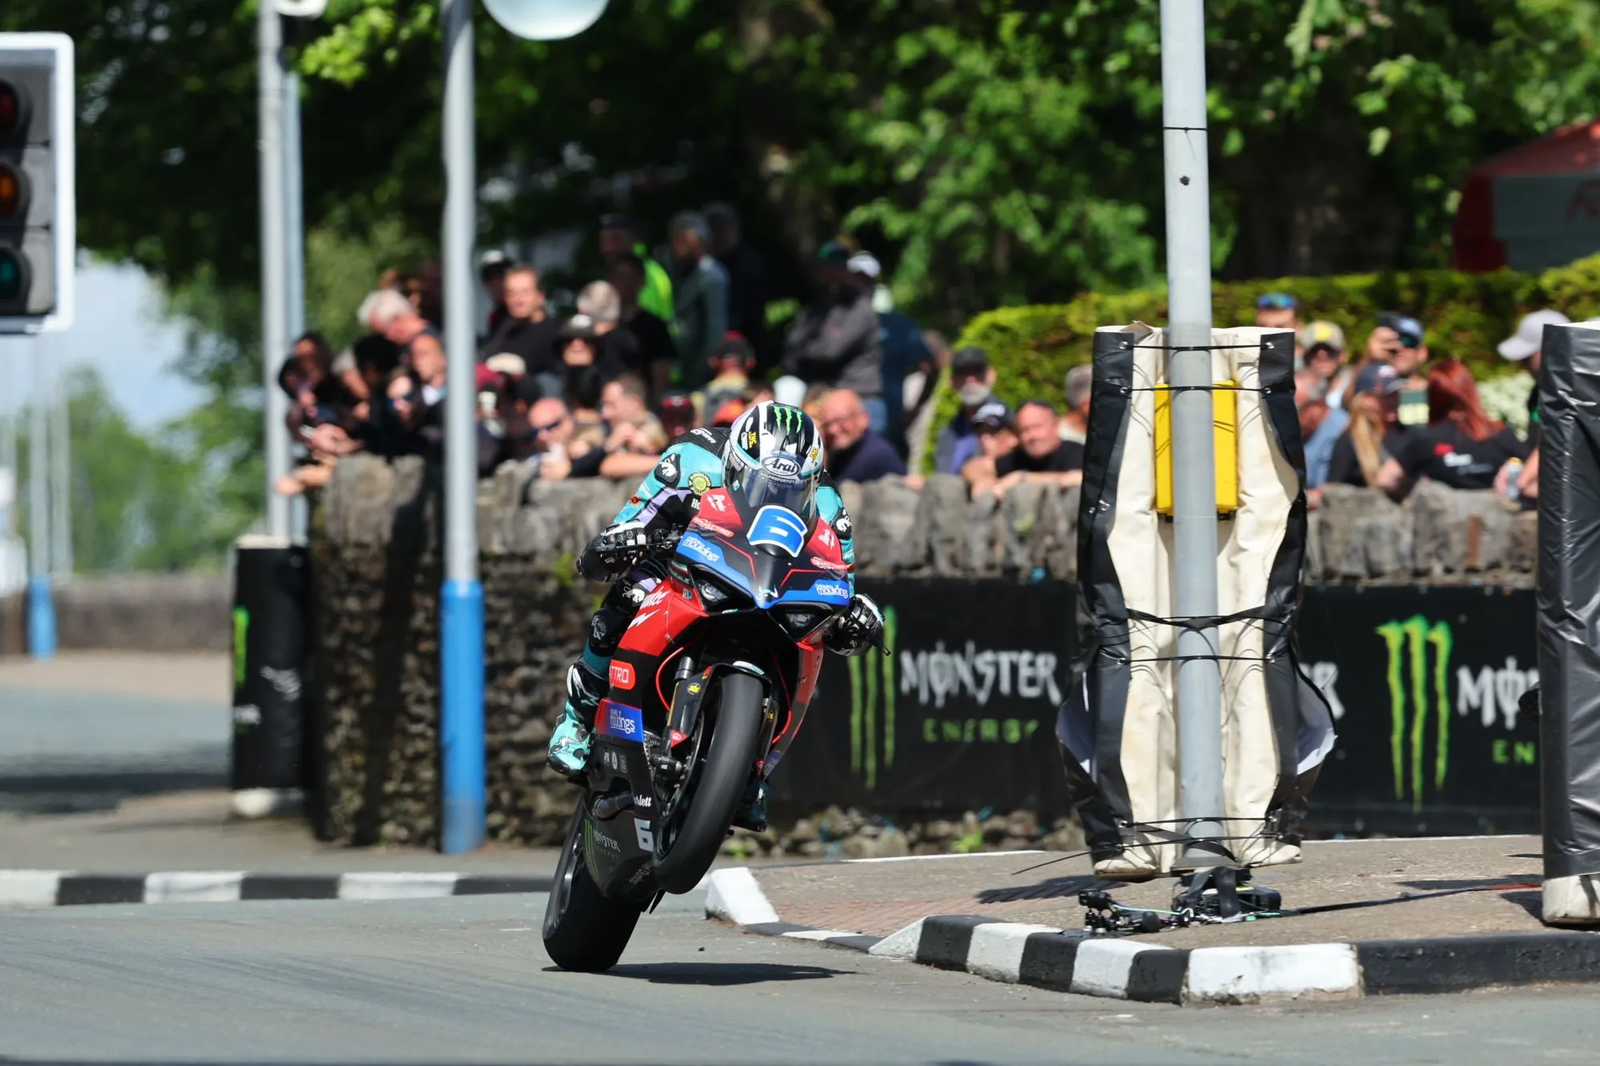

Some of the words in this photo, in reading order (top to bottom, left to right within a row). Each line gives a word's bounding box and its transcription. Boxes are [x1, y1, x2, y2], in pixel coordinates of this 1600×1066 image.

[764, 458, 797, 473] Arai
[900, 638, 1062, 708] MONSTER
[633, 817, 654, 853] 6
